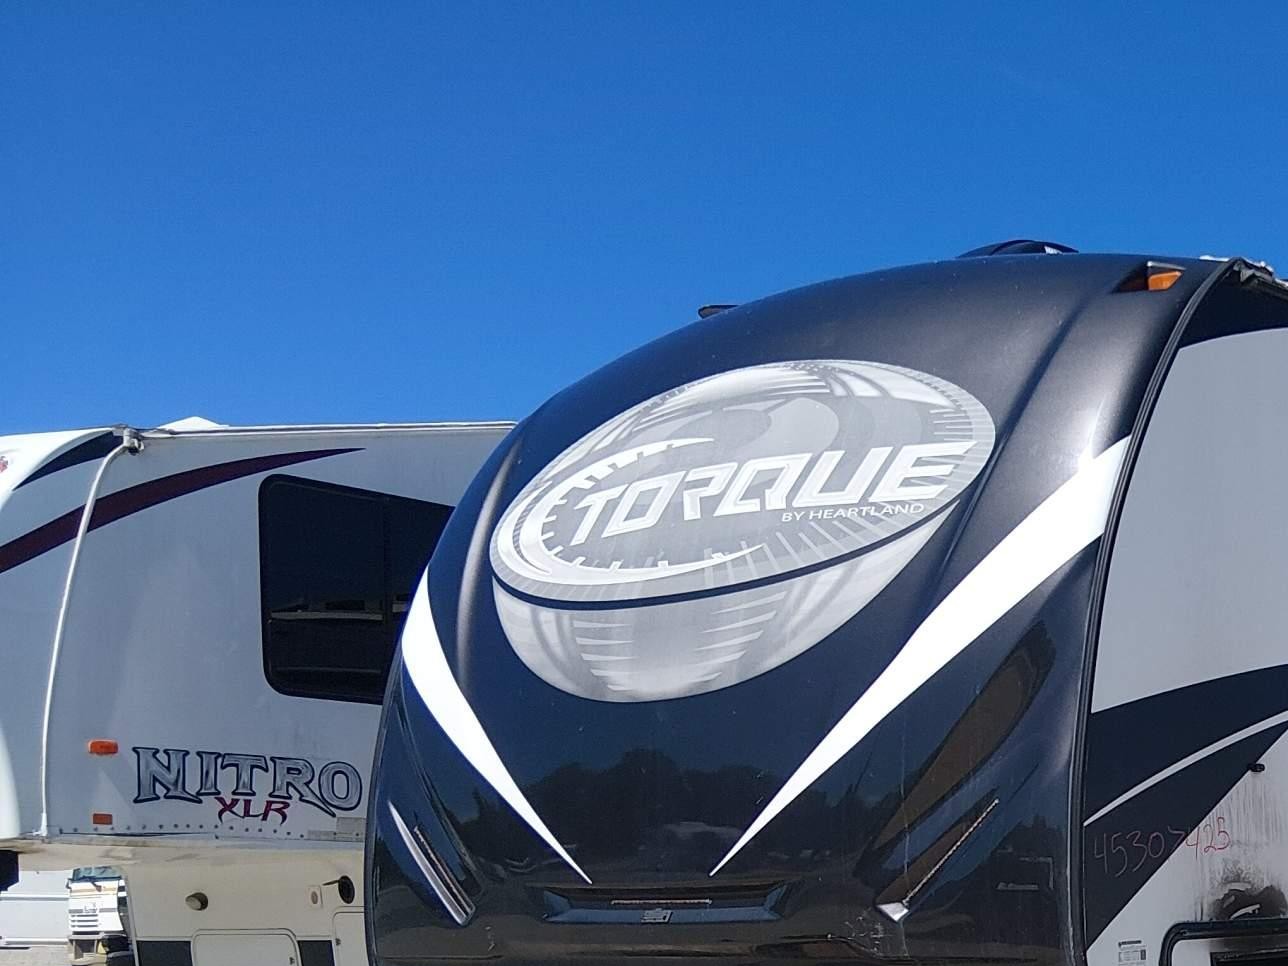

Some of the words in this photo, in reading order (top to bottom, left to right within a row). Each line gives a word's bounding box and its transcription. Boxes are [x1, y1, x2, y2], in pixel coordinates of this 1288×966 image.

[569, 441, 977, 546] TORQUE
[781, 511, 805, 522] BY
[808, 503, 925, 520] HEARTLAND
[132, 747, 363, 818] NITRO
[214, 796, 291, 826] XLR
[1094, 816, 1231, 877] 45307425
